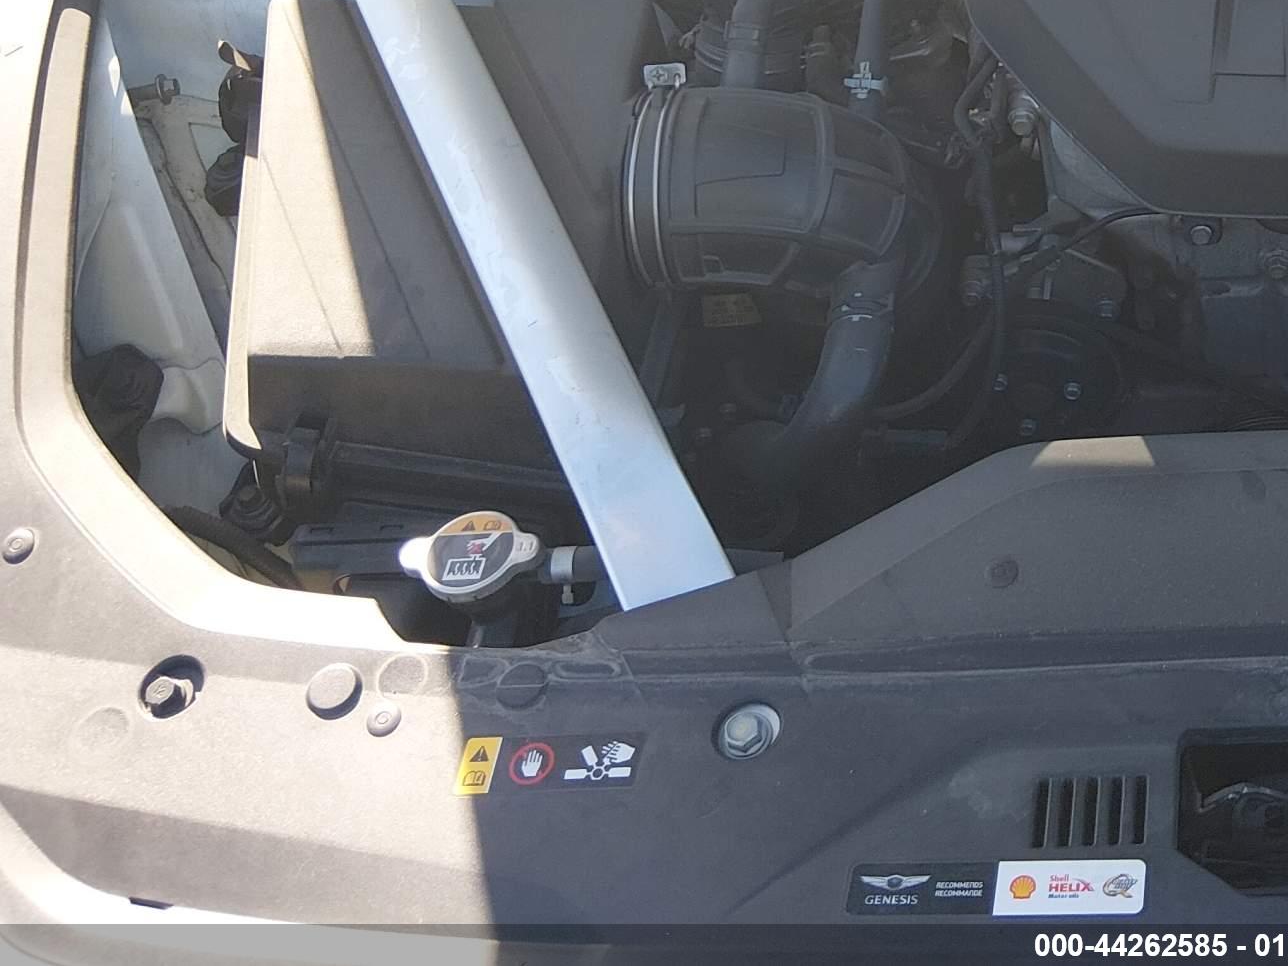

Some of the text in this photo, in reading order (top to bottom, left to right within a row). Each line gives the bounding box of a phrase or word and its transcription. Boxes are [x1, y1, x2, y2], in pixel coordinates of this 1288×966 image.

[1049, 874, 1069, 882] Shell
[935, 881, 983, 889] RECOMMENDS
[1048, 881, 1095, 892] HELIX
[864, 894, 919, 905] GENESIS
